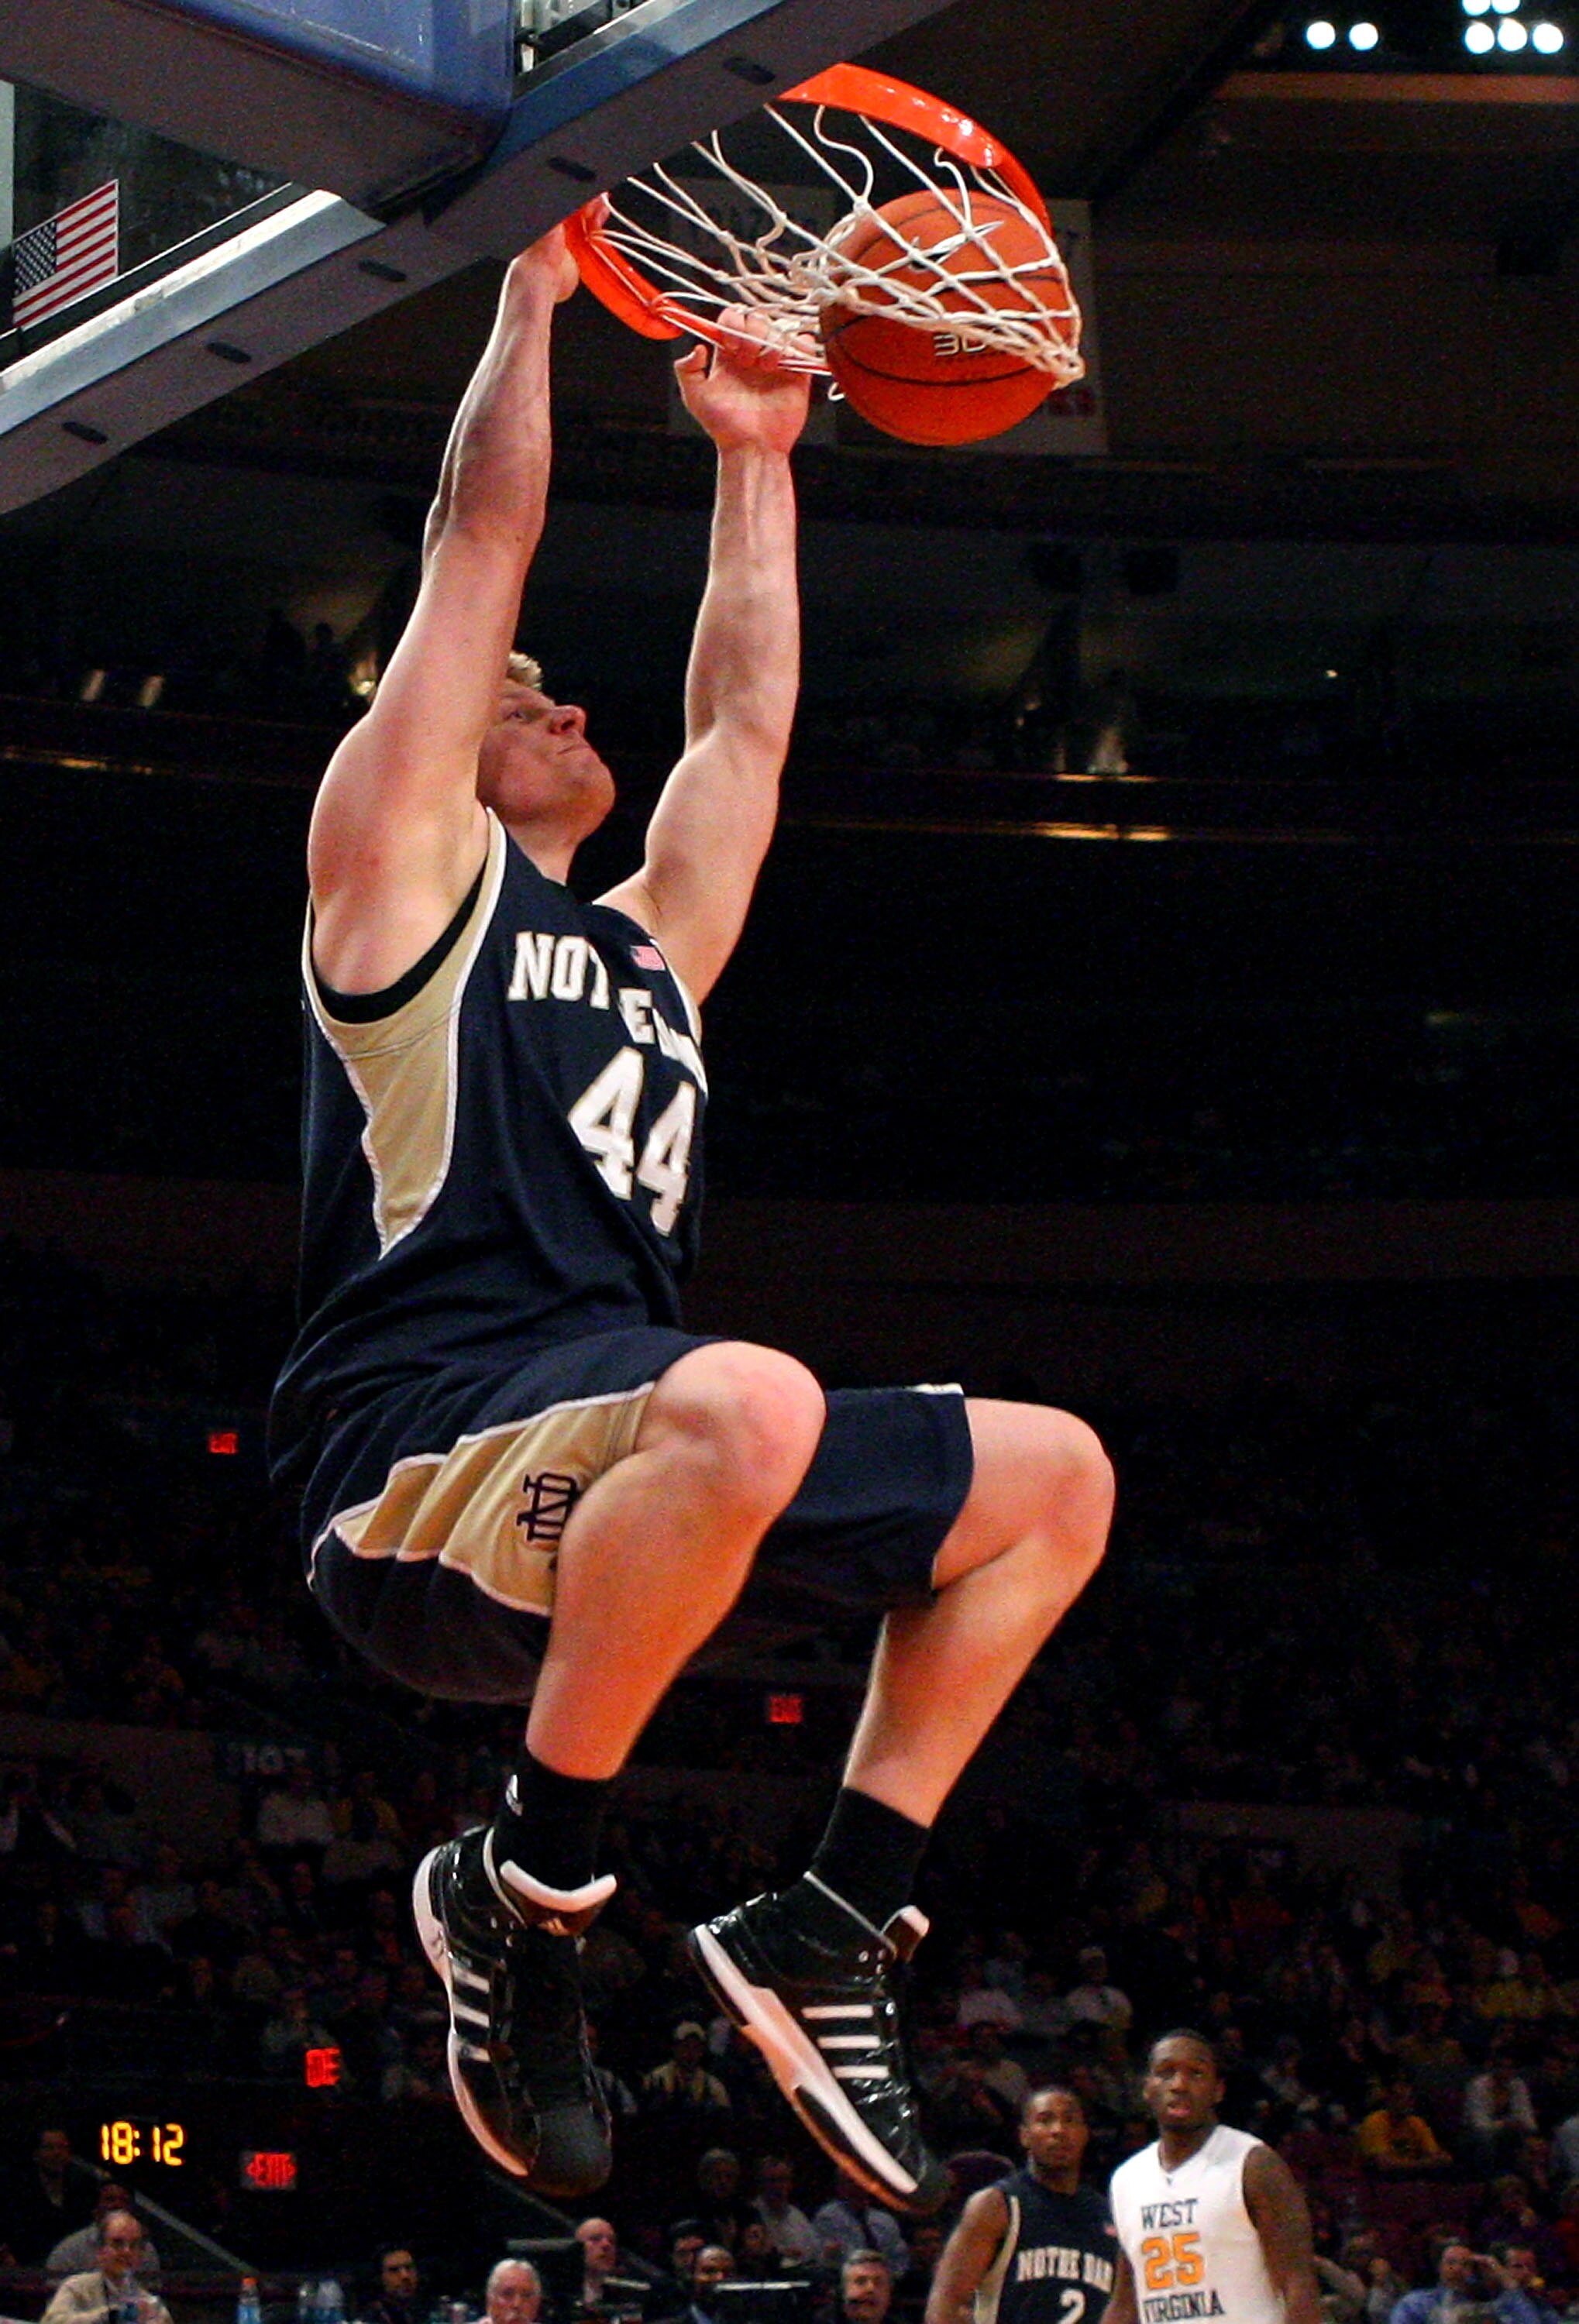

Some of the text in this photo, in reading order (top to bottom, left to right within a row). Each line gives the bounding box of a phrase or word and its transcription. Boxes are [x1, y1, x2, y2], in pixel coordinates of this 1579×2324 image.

[568, 1046, 697, 1237] 44
[101, 2121, 185, 2166] 18:12
[1141, 2198, 1199, 2229] WEST
[1017, 2246, 1082, 2281] NOTRE
[1142, 2232, 1206, 2291] 25
